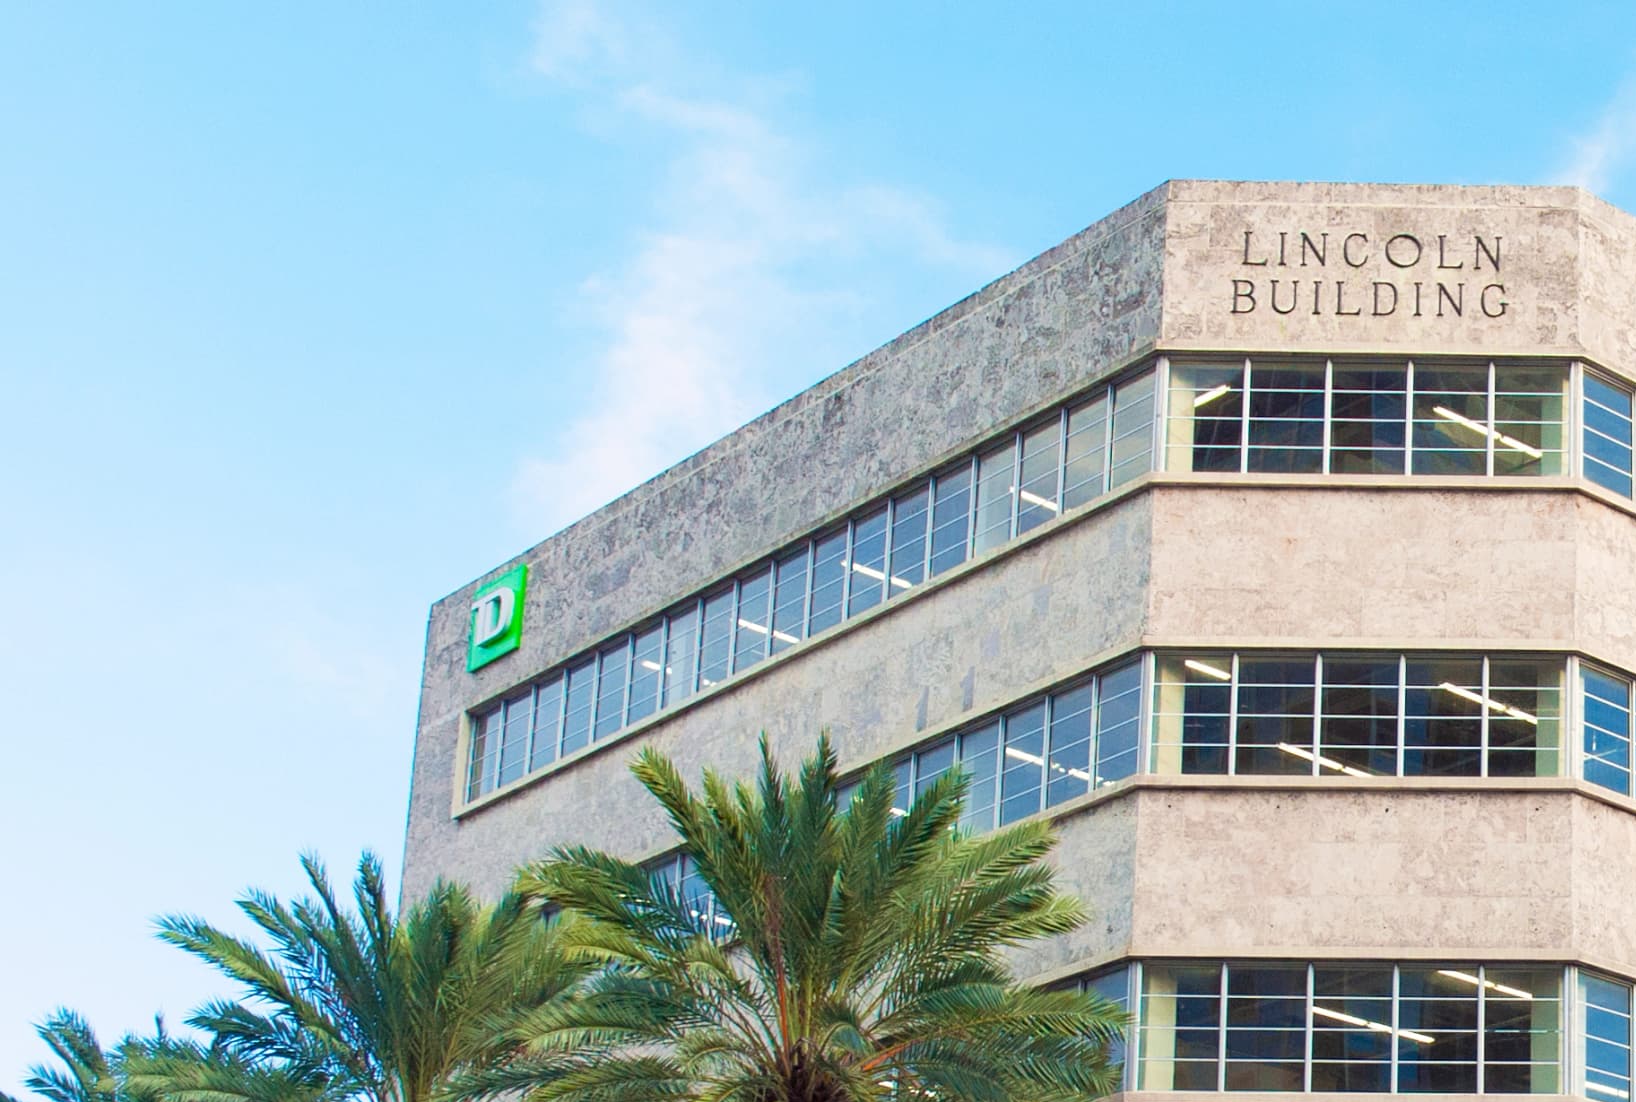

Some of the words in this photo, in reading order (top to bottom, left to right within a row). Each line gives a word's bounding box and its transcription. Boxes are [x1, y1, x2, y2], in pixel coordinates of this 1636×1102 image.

[1241, 231, 1503, 272] LINCOLN
[1230, 279, 1509, 318] BUILDING
[471, 586, 515, 647] TD
